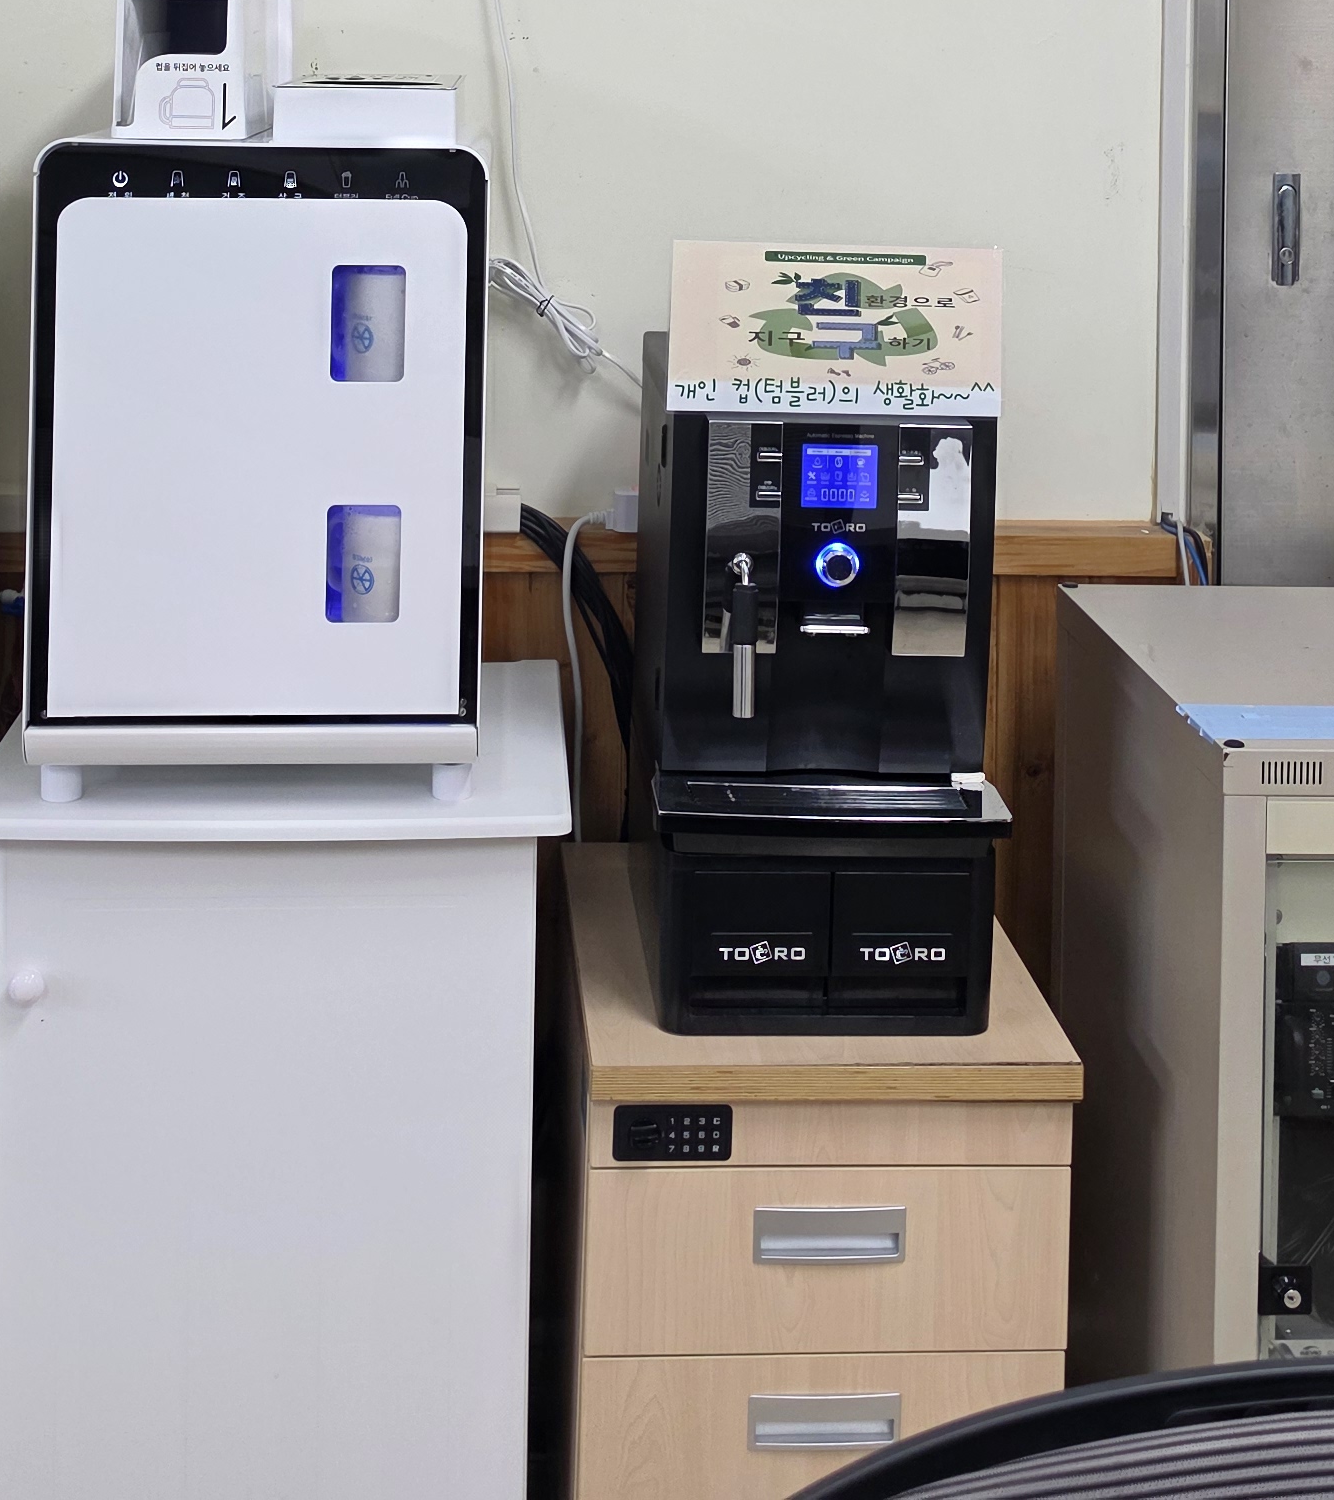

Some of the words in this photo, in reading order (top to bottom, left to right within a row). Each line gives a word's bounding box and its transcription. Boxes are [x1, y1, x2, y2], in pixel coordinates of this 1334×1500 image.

[155, 62, 171, 72] 컵을
[173, 62, 197, 72] 뒤집어
[198, 62, 231, 73] 놓으세요
[777, 253, 825, 262] Upcycling
[866, 256, 914, 264] Campaign
[748, 330, 806, 346] 지구
[674, 377, 718, 402] 개인
[731, 376, 859, 408] 컵(텀블러)의
[670, 1117, 675, 1125] 1
[683, 1117, 691, 1125] 2
[698, 1117, 706, 1125] 3
[668, 1131, 676, 1139] 4
[682, 1131, 690, 1139] 5
[698, 1131, 706, 1139] 6
[668, 1145, 675, 1153] 7
[682, 1145, 690, 1153] 8
[697, 1145, 705, 1153] 9
